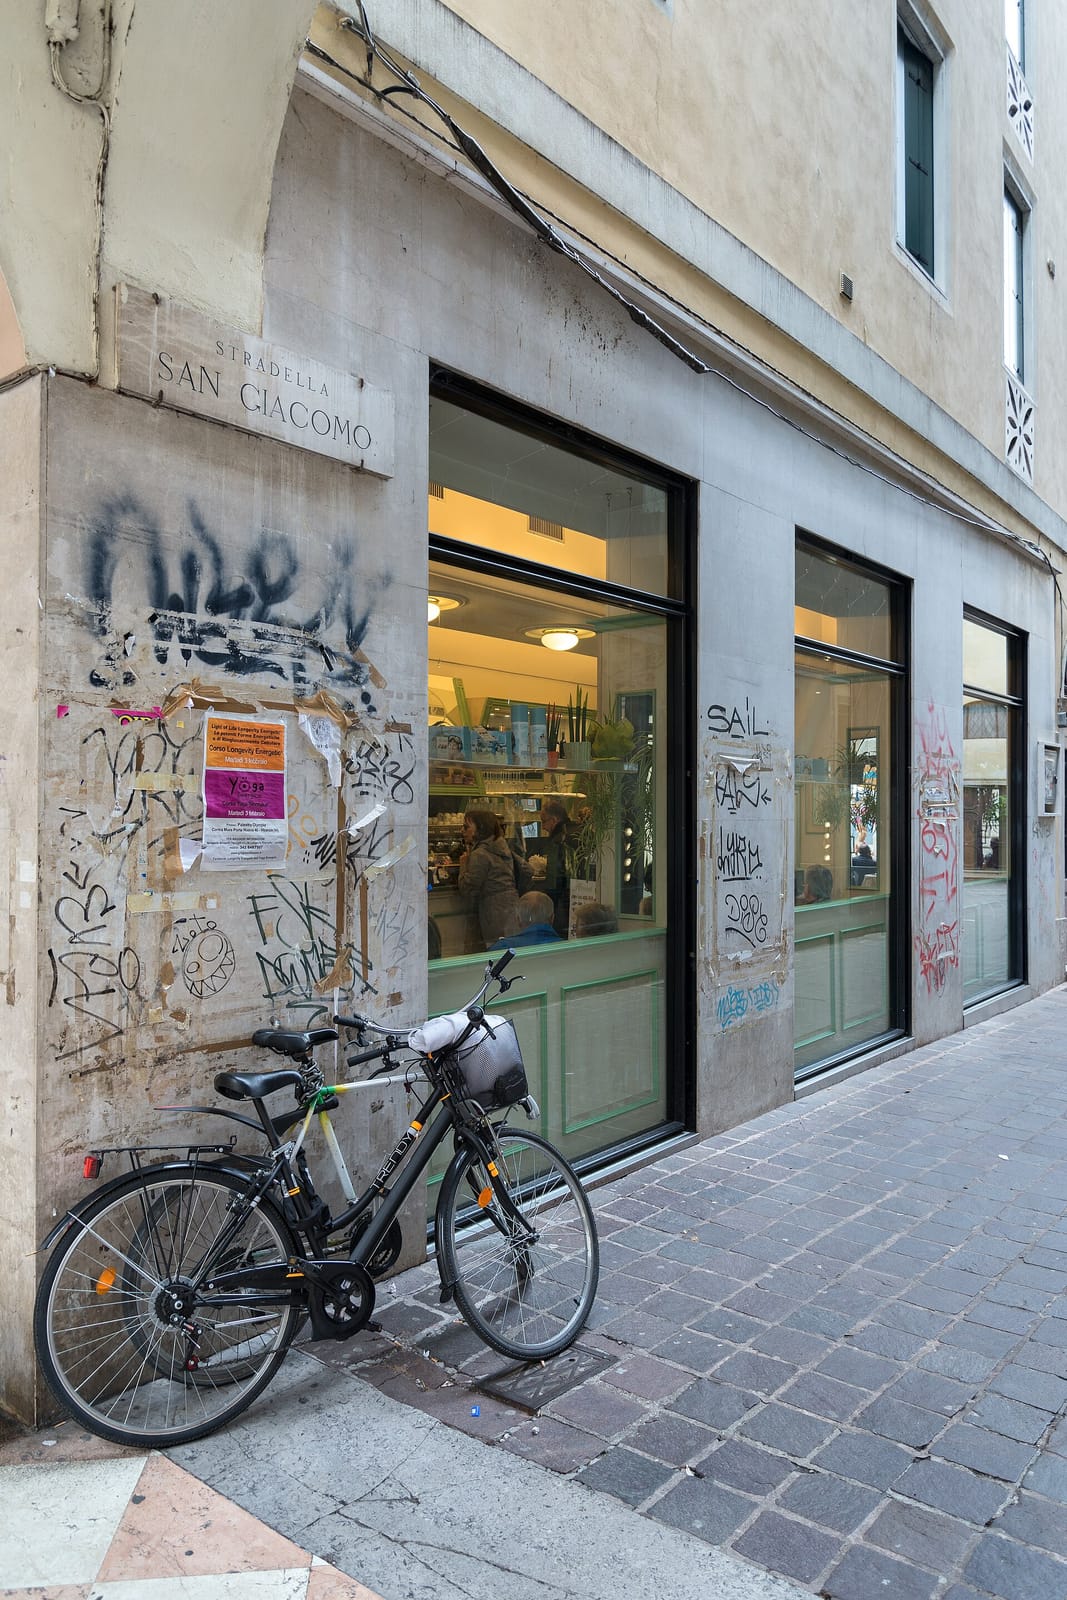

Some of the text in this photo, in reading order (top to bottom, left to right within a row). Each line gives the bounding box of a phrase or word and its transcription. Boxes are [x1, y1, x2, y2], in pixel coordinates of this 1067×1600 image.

[215, 340, 329, 397] STRADELLA
[158, 351, 372, 450] SAN GIACOMO
[227, 746, 254, 755] Longevity
[369, 1131, 413, 1189] TRENDY
